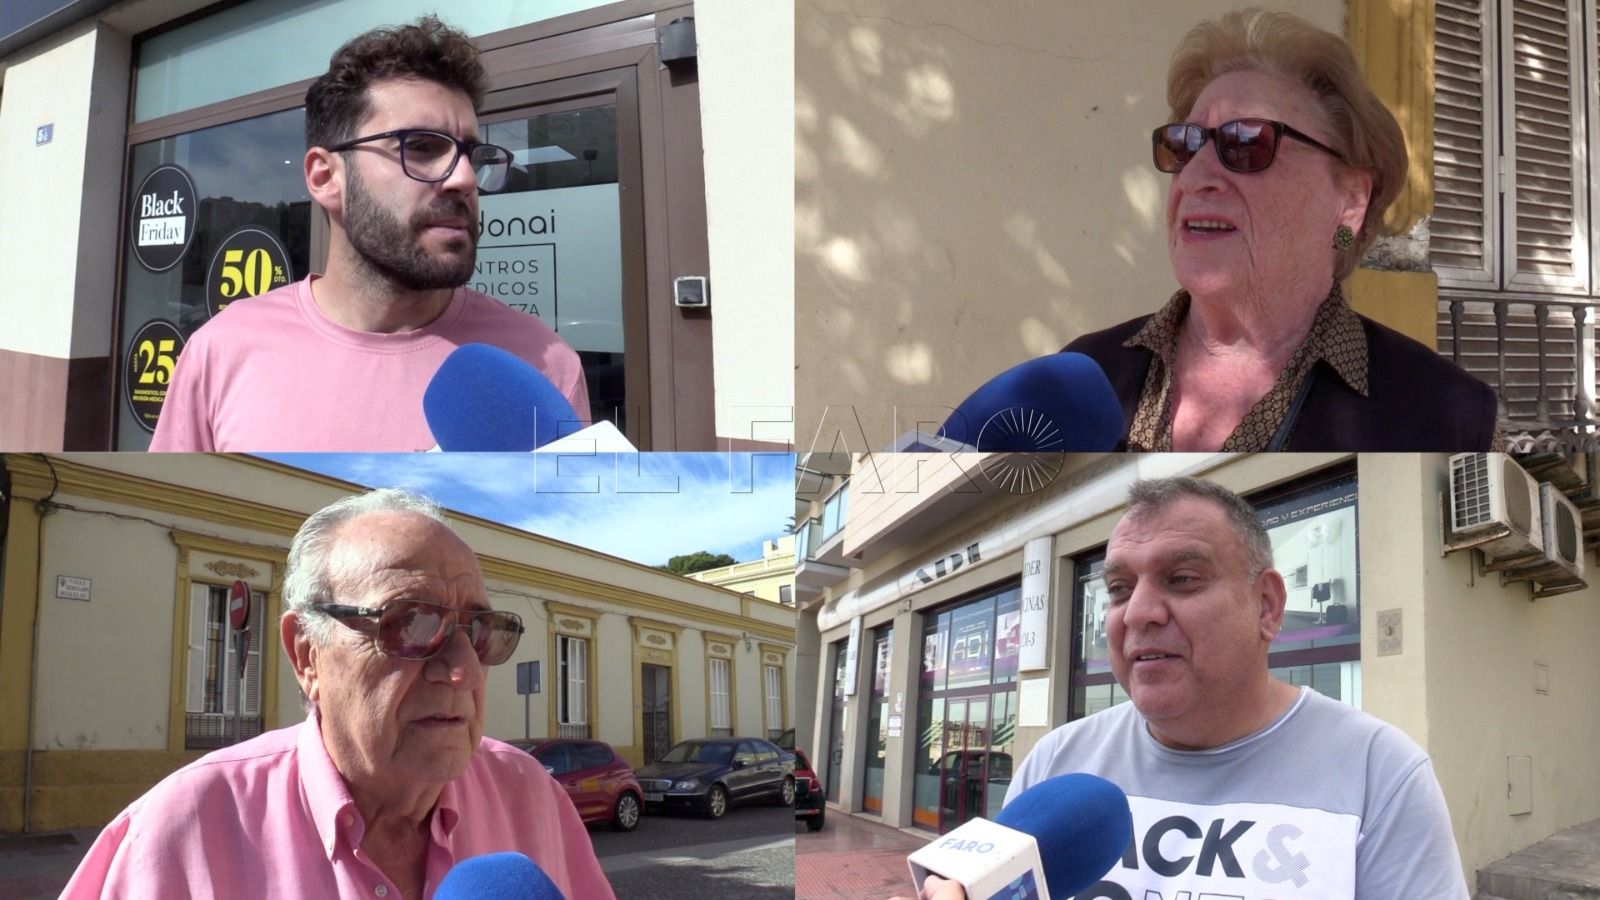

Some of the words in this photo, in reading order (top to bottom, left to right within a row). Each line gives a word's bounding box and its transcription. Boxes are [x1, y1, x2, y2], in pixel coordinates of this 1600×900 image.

[141, 190, 185, 217] Black
[141, 221, 182, 247] Friday
[220, 248, 273, 298] 50
[465, 281, 539, 296] DICOS
[139, 340, 176, 385] 25
[939, 838, 995, 854] FARO
